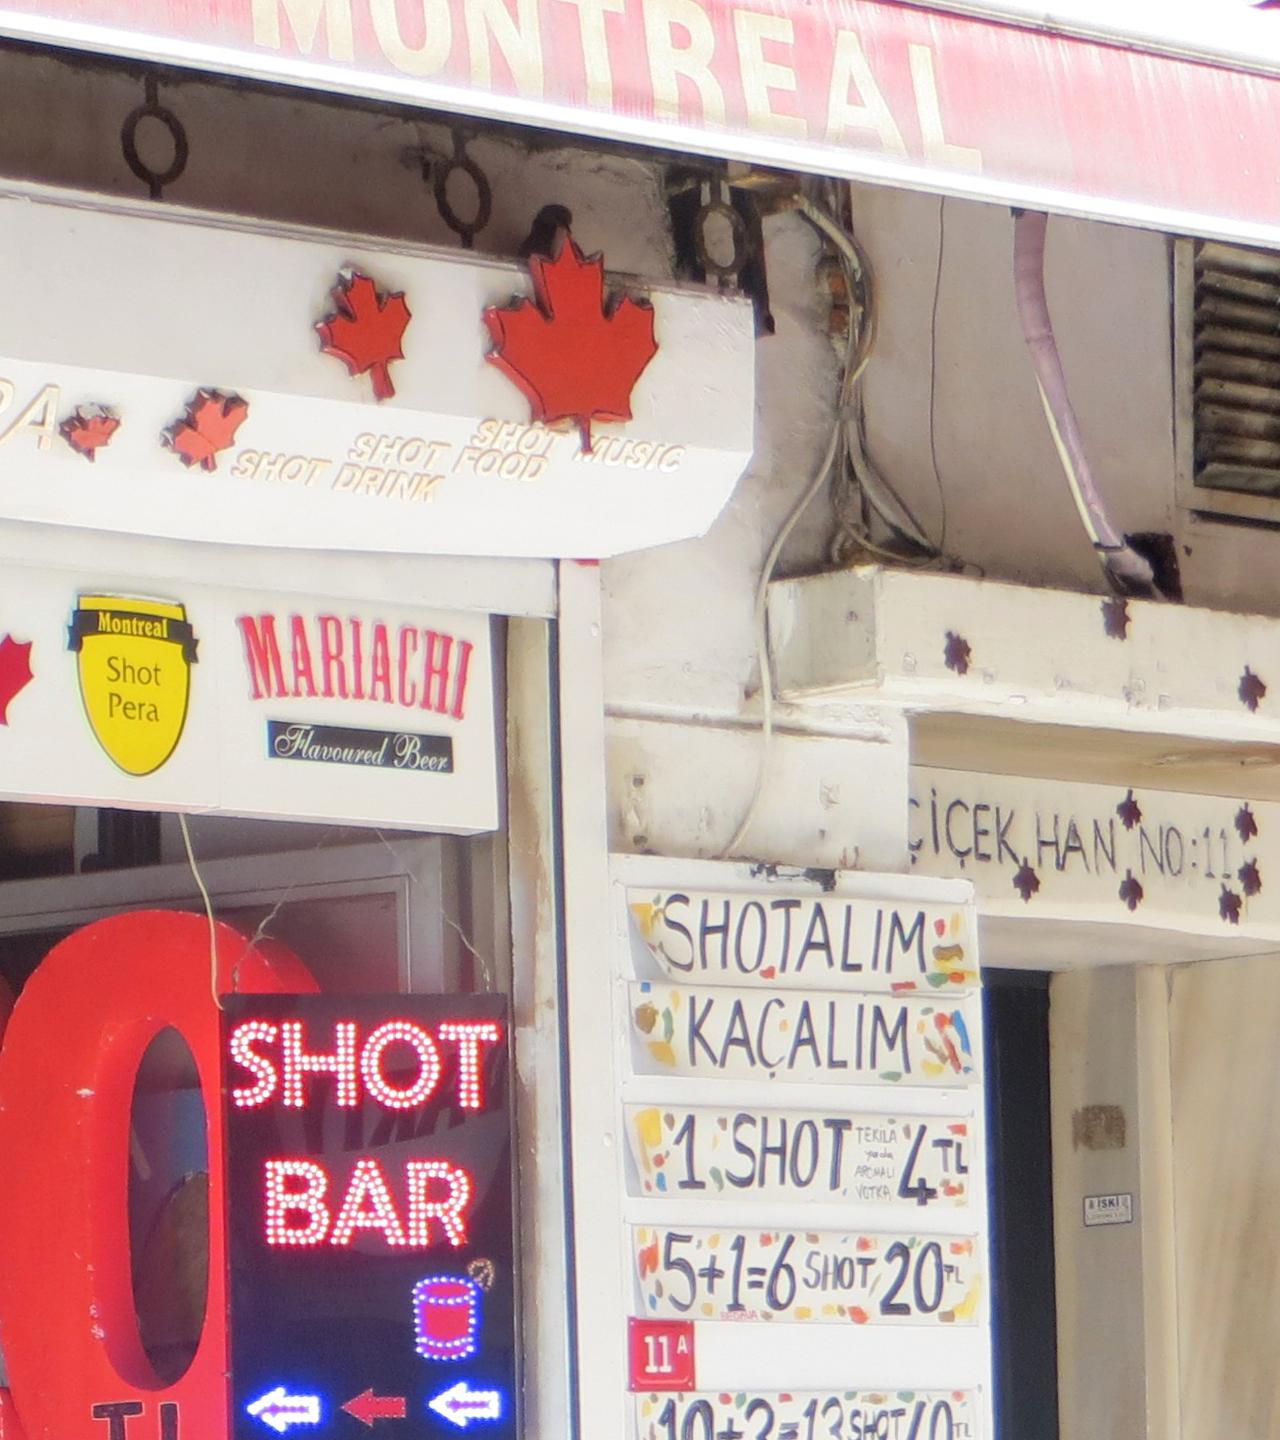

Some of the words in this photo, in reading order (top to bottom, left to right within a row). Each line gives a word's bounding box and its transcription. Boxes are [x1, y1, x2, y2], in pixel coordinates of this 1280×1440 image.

[347, 432, 453, 469] SHOT
[452, 446, 550, 484] FOOD
[470, 418, 571, 458] SHOT
[230, 448, 333, 490] SHOT
[332, 463, 446, 505] DRINK
[96, 610, 169, 640] Montreal
[106, 656, 162, 687] Shot
[235, 612, 474, 721] MARIACHI
[107, 691, 160, 724] Pera
[273, 723, 386, 768] Flavoured
[392, 734, 449, 772] Beer
[1036, 811, 1118, 876] HAN
[660, 892, 927, 974] SHOTALIM
[229, 1020, 501, 1109] SHOT
[688, 994, 913, 1080] KAÇALIM
[672, 1113, 707, 1190] 1
[725, 1112, 853, 1192] SHOT
[896, 1124, 939, 1207] 4
[931, 1136, 969, 1176] TL
[264, 1157, 472, 1249] BAR
[801, 1249, 878, 1293] SHOT
[878, 1239, 945, 1318] 20
[643, 1335, 672, 1373] 11
[675, 1334, 689, 1355] A
